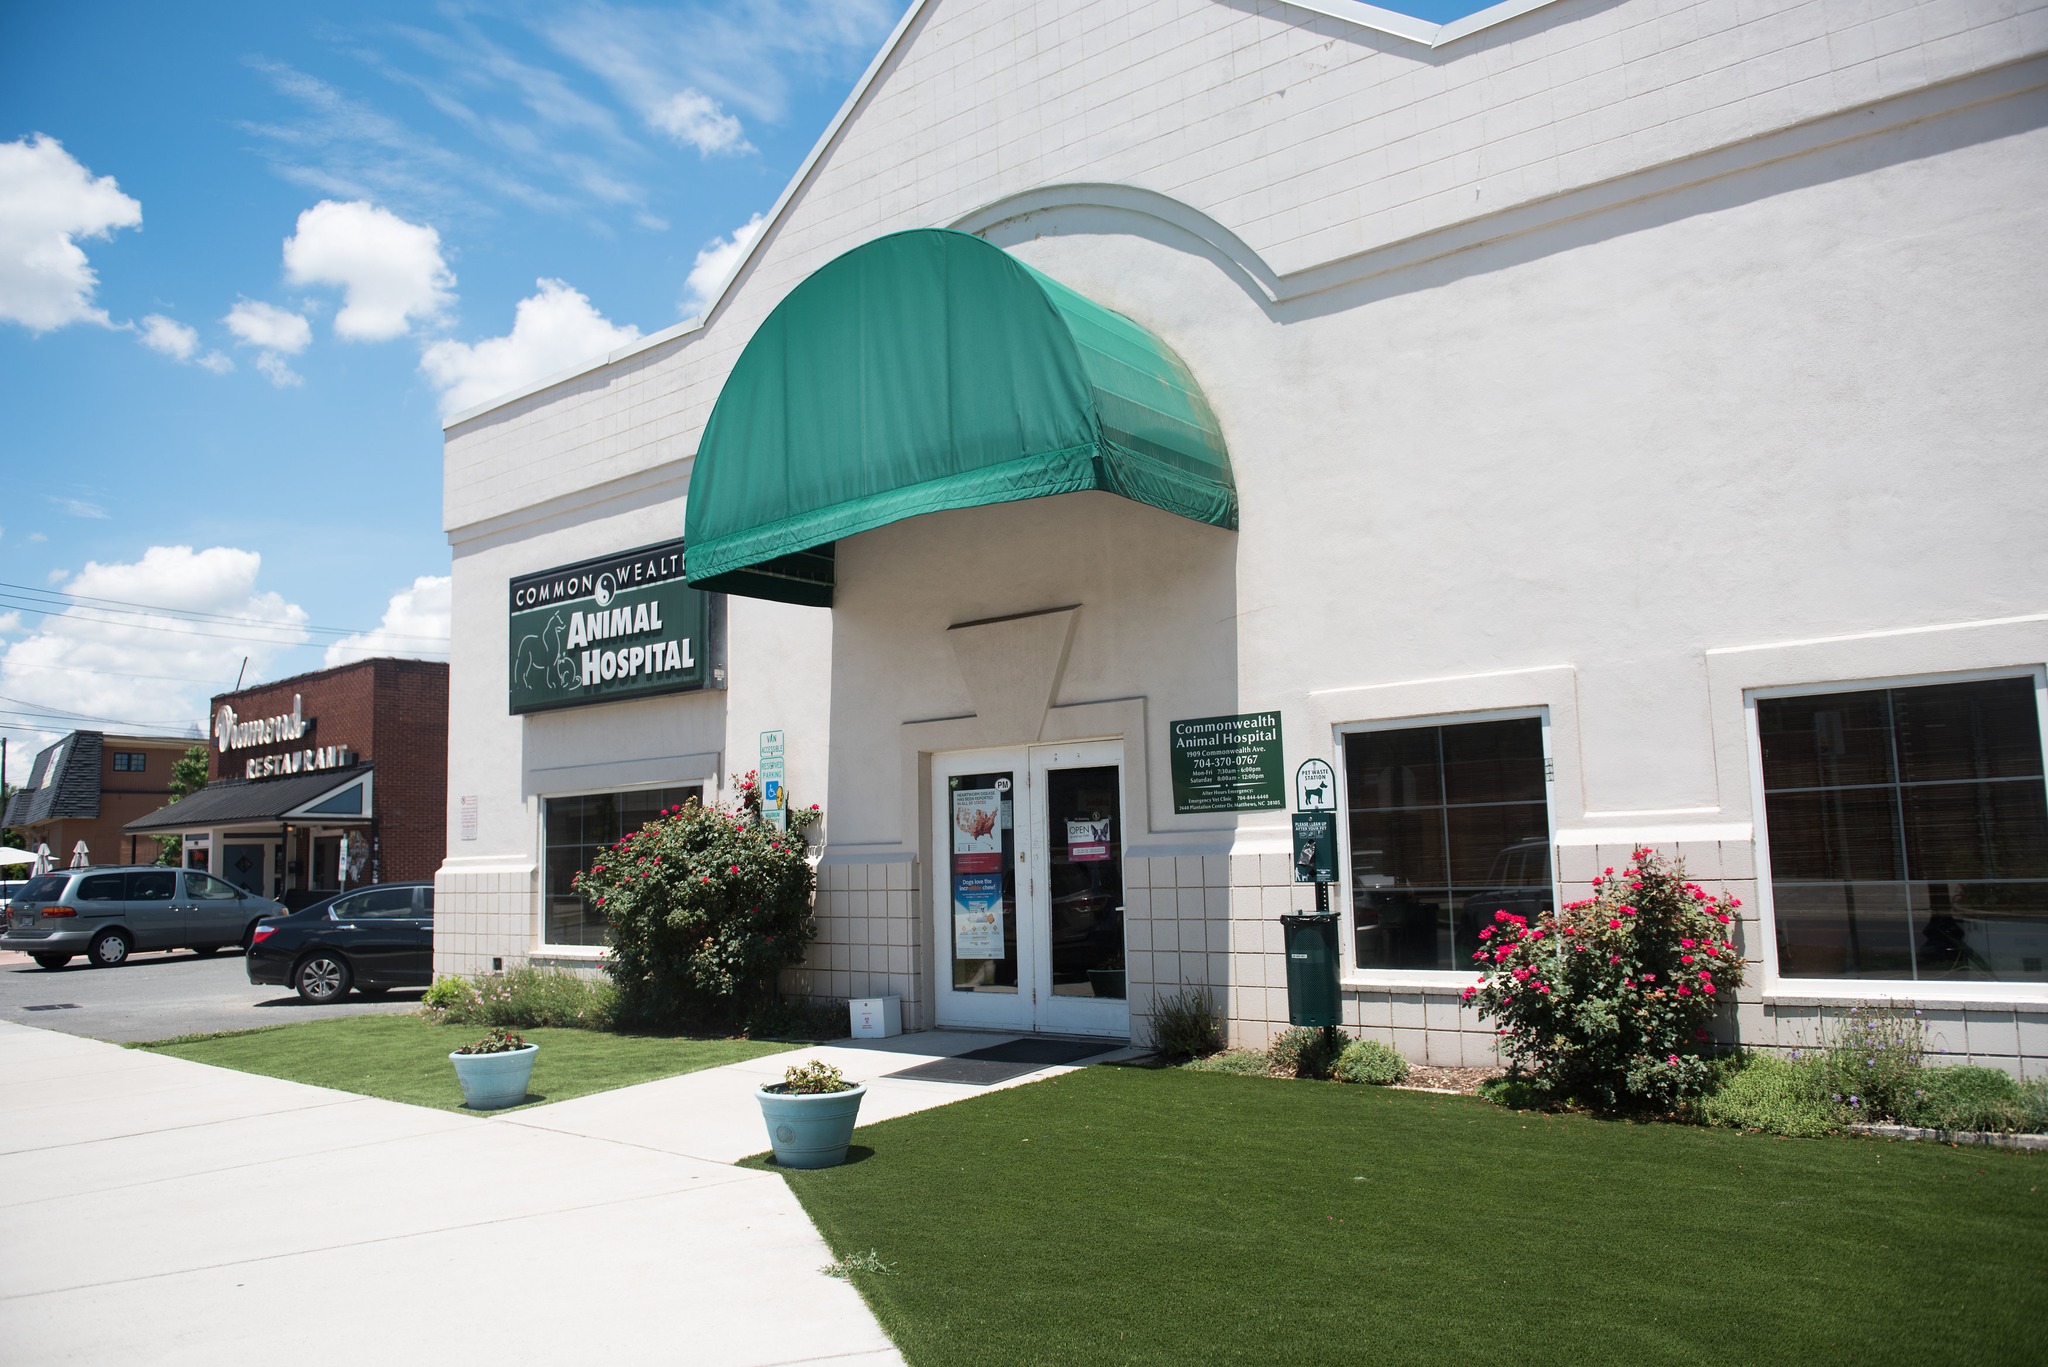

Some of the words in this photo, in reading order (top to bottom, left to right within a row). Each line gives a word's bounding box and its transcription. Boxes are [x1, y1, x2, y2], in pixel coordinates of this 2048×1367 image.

[516, 574, 593, 607] COMMON
[566, 600, 663, 650] ANIMAL
[581, 638, 695, 687] HOSPITAL
[1176, 714, 1276, 735] Commonwealth
[766, 734, 777, 743] VAN
[1176, 733, 1219, 749] Animal
[1223, 728, 1277, 745] Hospital
[761, 744, 783, 754] ACCESSIBLE
[1186, 749, 1201, 758] 1909
[1201, 747, 1251, 756] Commonwealth
[246, 744, 348, 780] RESTAURANT
[761, 761, 783, 770] RESERVED
[1193, 754, 1258, 769] 704-370-0767
[762, 770, 782, 779] PARKING
[997, 781, 1008, 789] PM
[1069, 825, 1090, 835] OPEN
